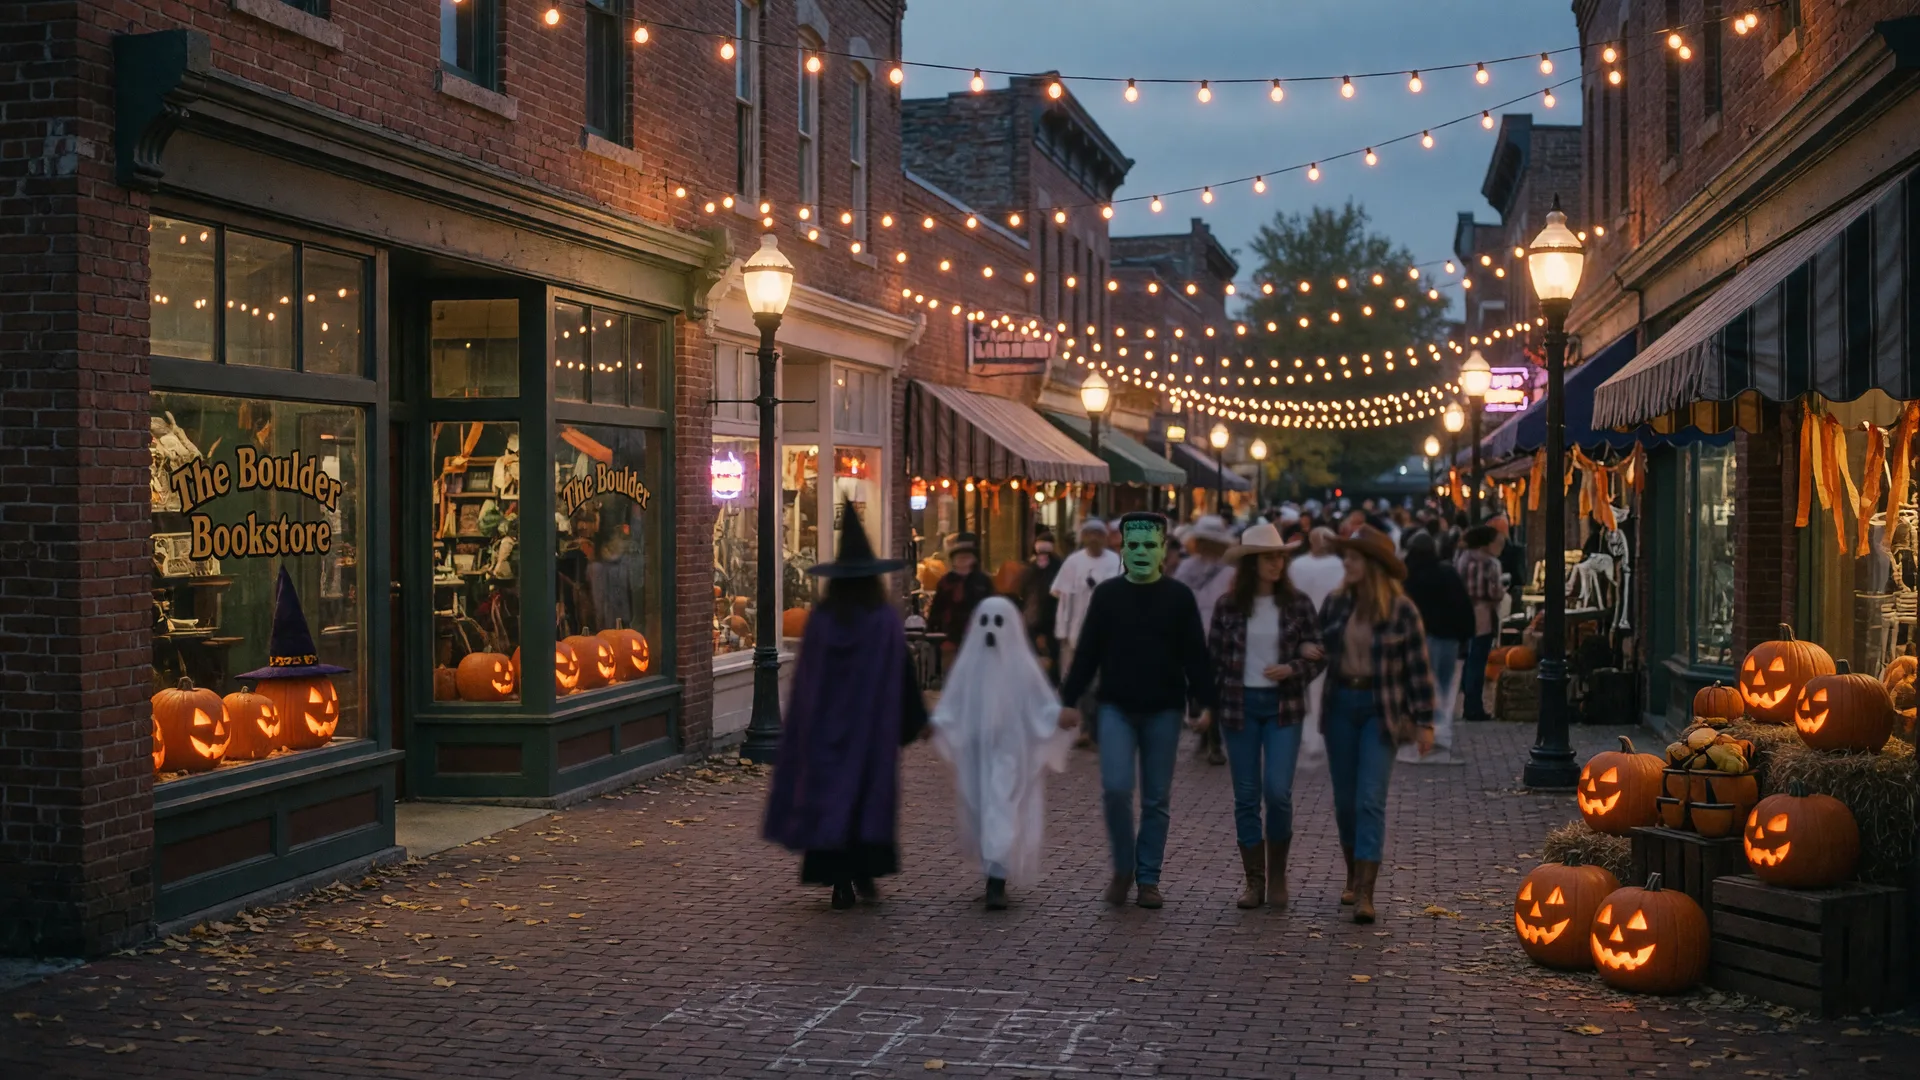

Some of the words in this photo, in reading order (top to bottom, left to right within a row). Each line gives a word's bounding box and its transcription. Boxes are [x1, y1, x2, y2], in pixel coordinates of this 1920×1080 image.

[171, 458, 230, 515] The
[236, 446, 341, 512] Boulder
[563, 475, 593, 517] The
[597, 462, 650, 509] Boulder
[190, 512, 331, 560] Bookstore
